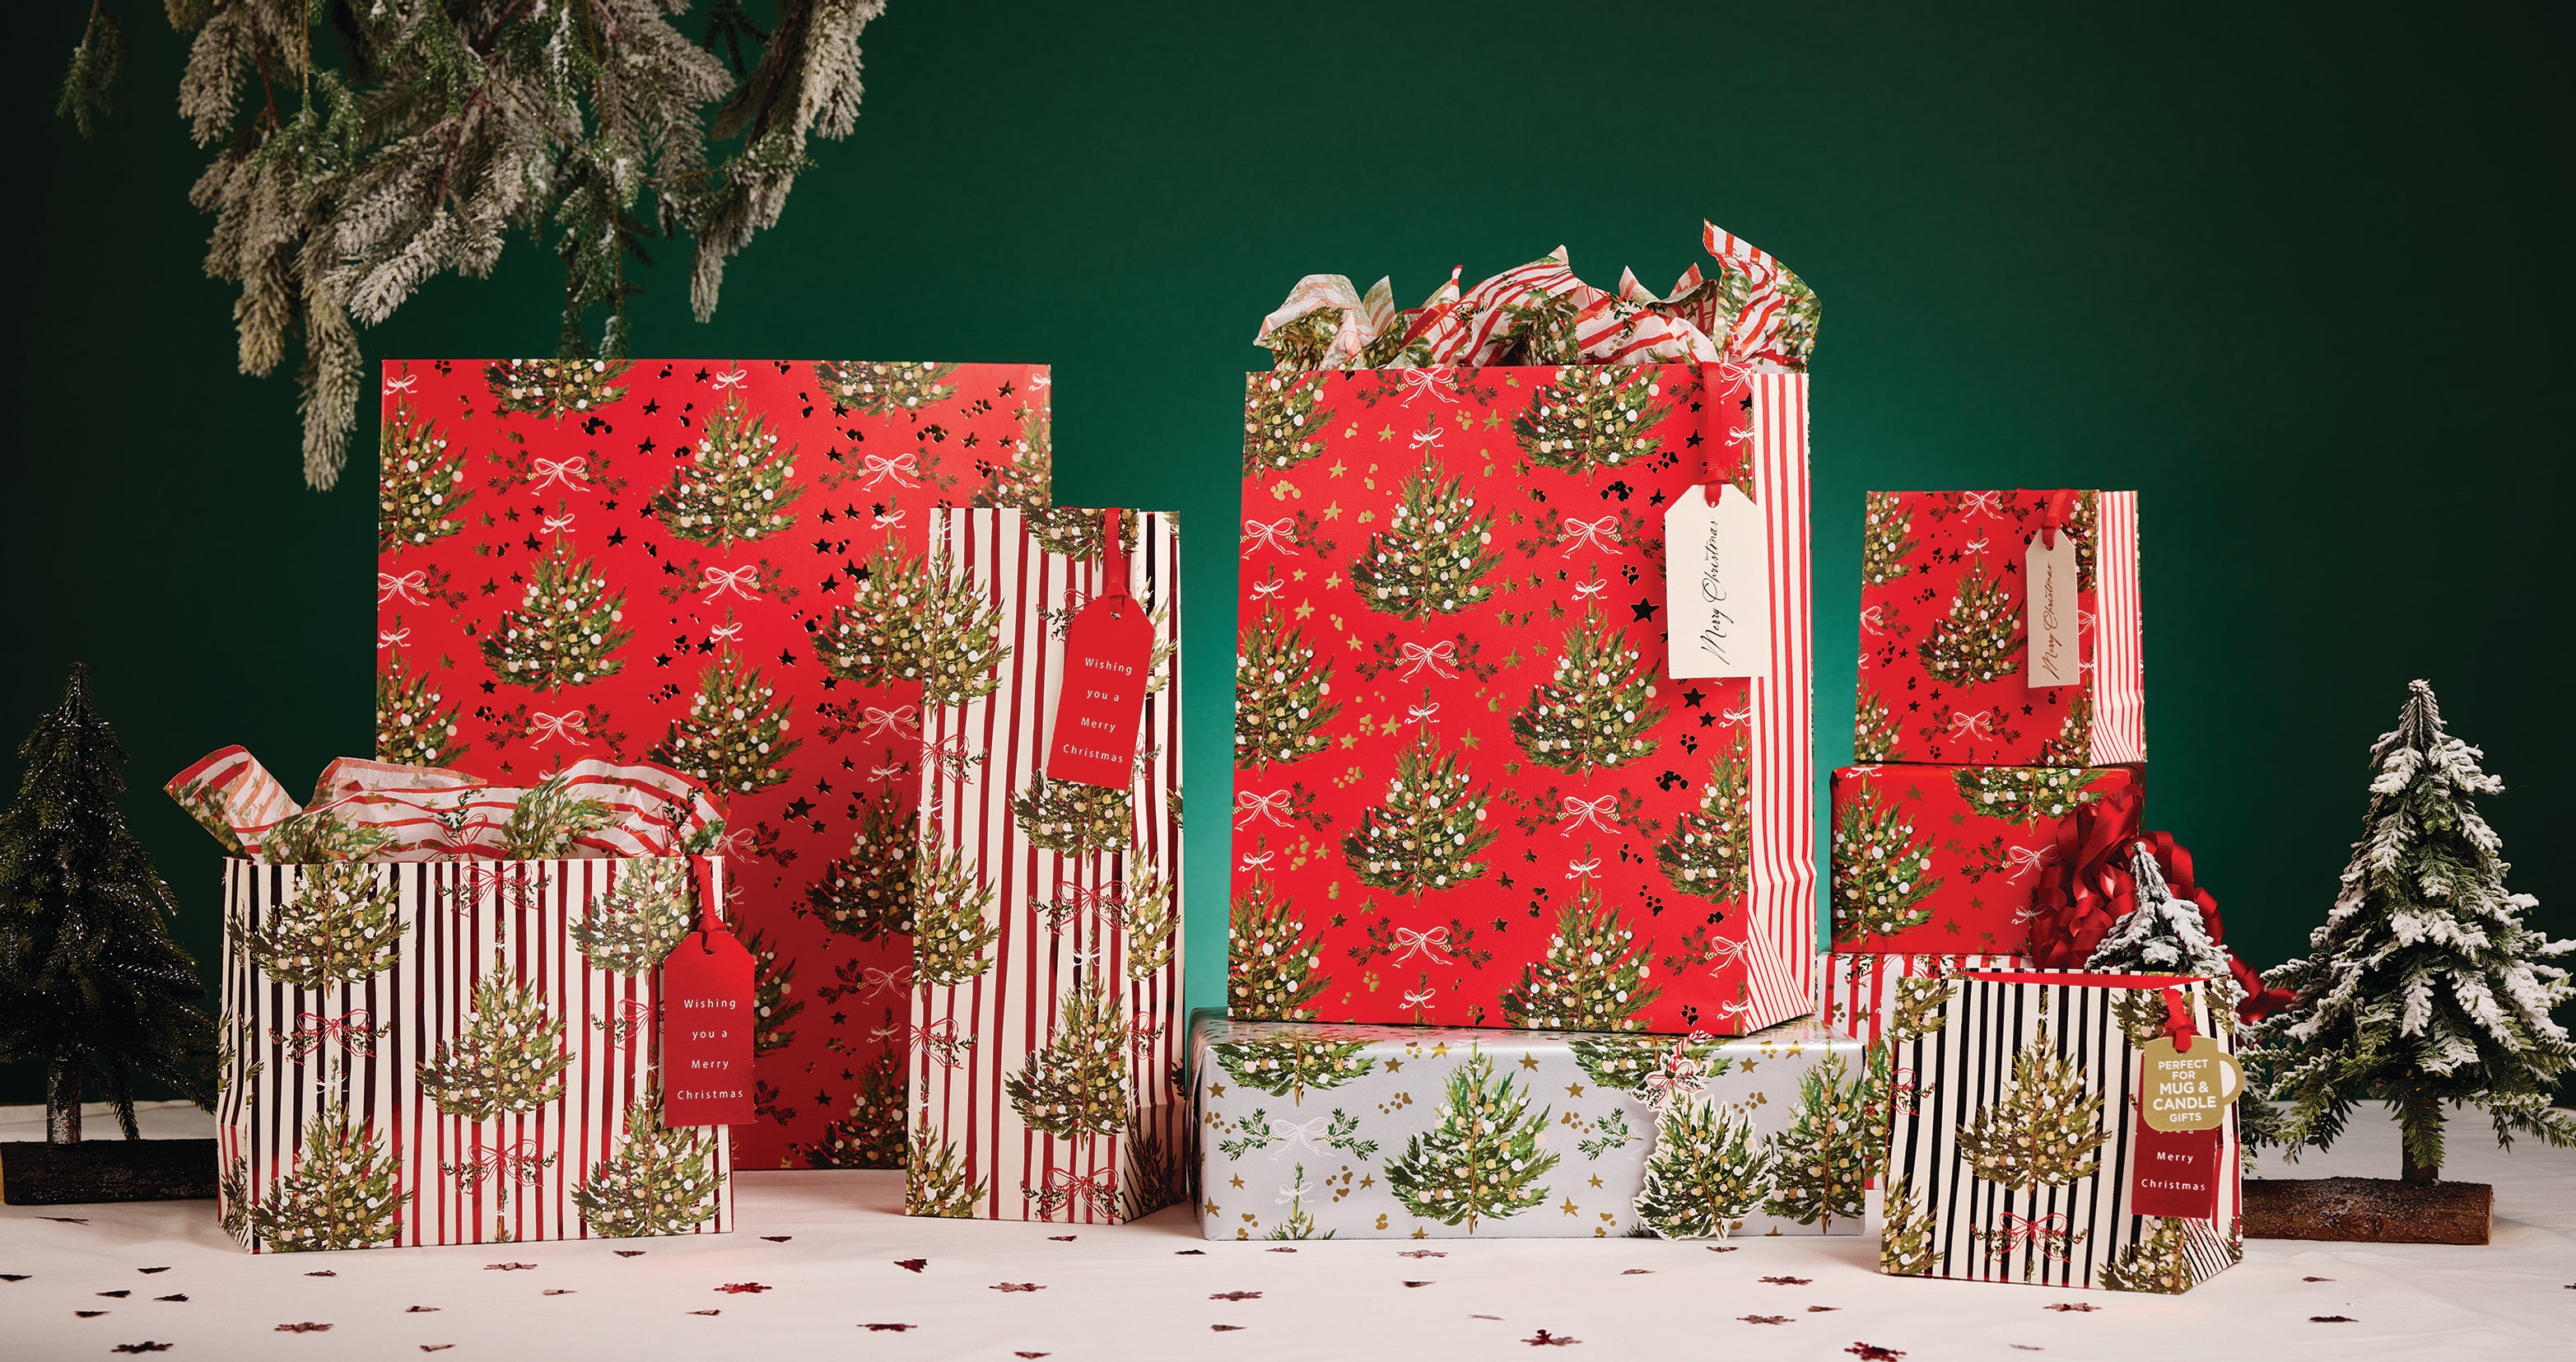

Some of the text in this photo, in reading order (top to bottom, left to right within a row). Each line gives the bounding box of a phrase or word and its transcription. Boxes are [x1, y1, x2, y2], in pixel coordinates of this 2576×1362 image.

[1700, 516, 1734, 665] Merry Christmas
[2043, 562, 2061, 680] Merry Christmas
[1085, 657, 1132, 676] Wishing
[1088, 689, 1107, 700] you
[1082, 717, 1116, 732] Merry
[1064, 744, 1123, 763] Christmas
[684, 999, 736, 1009] Wishing
[692, 1031, 715, 1040] you
[692, 1060, 729, 1070] Merry
[2159, 1059, 2209, 1070] PERFECT
[2172, 1070, 2196, 1080] FOR
[678, 1089, 743, 1099] Christmas
[2159, 1081, 2209, 1095] MUG &
[2153, 1096, 2216, 1111] CANDLE
[2169, 1112, 2201, 1122] GIFTS
[2157, 1152, 2193, 1164] Merry
[2141, 1179, 2205, 1191] Christmas
